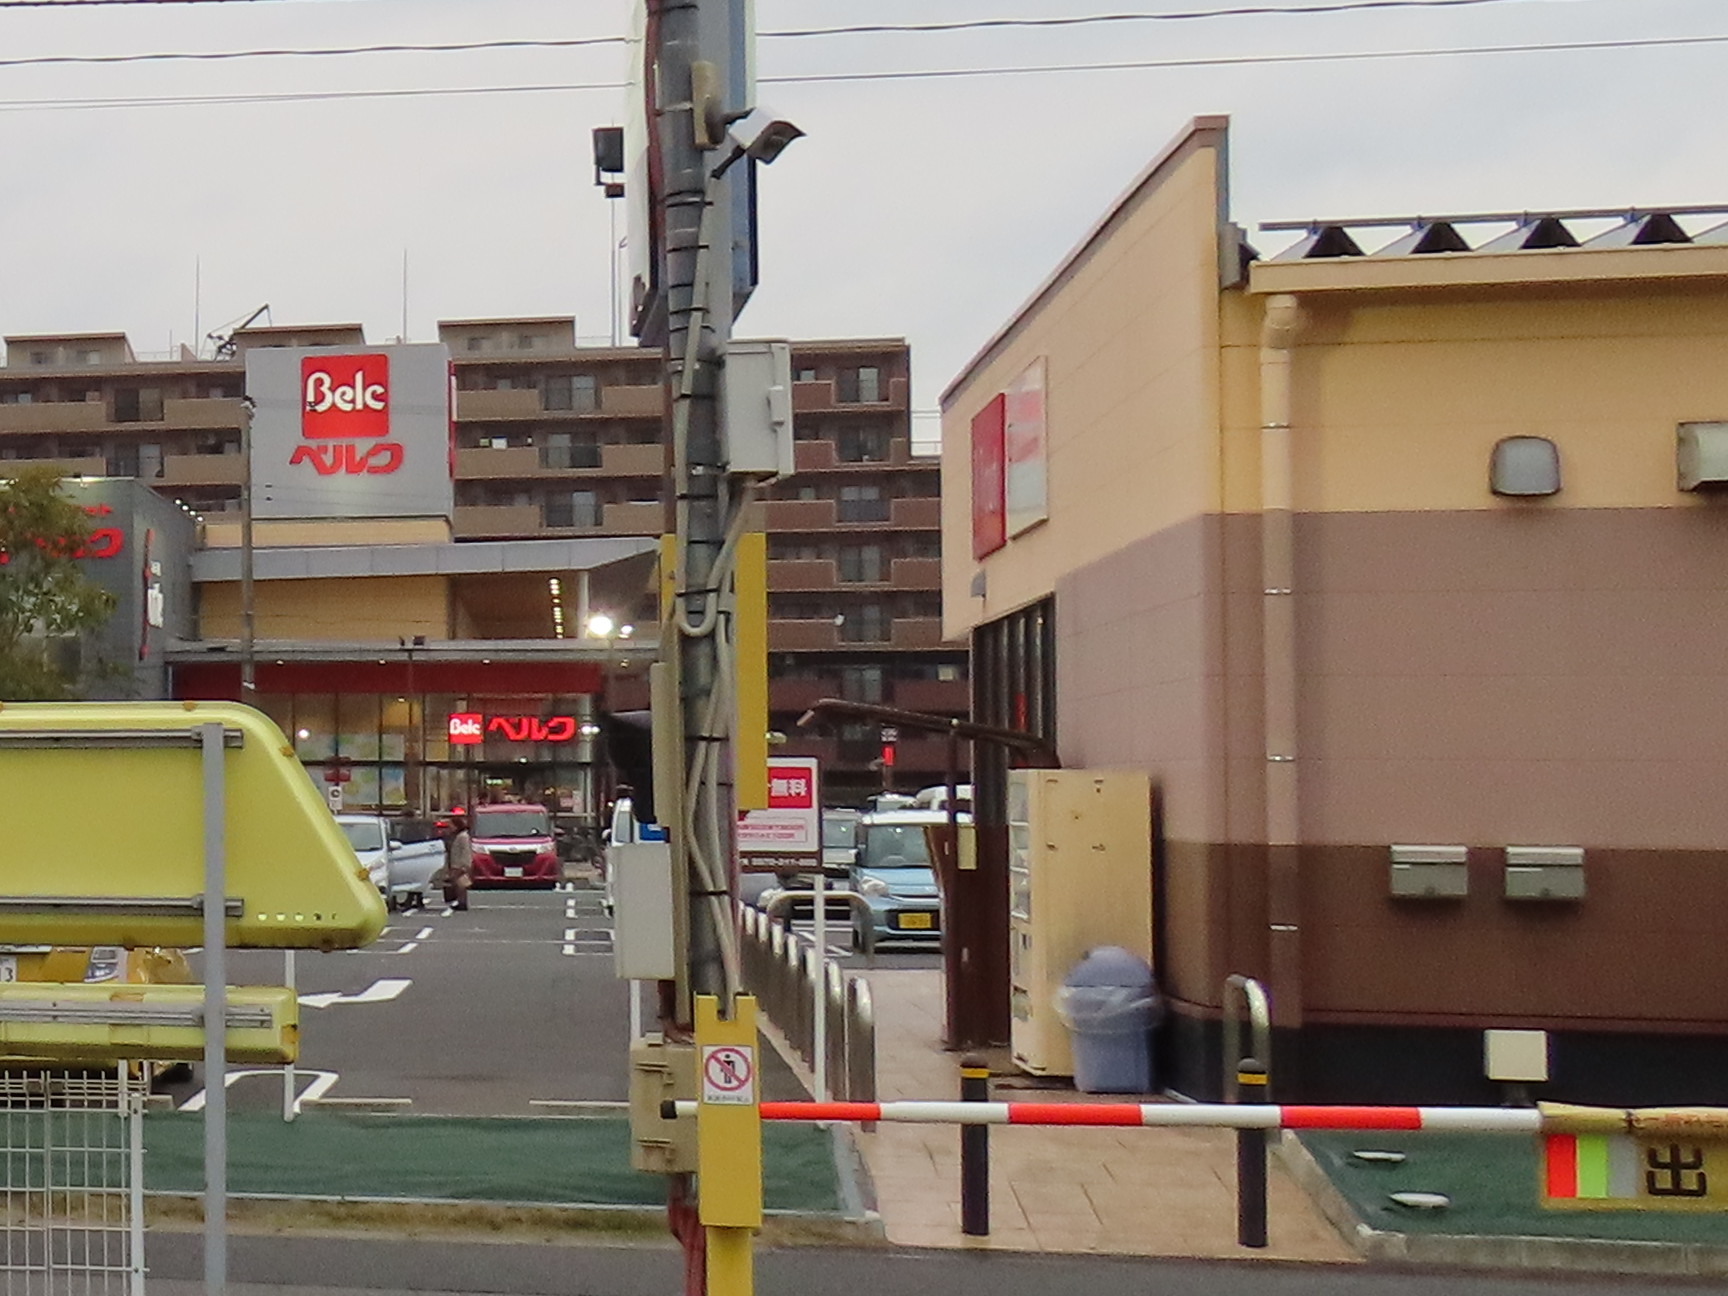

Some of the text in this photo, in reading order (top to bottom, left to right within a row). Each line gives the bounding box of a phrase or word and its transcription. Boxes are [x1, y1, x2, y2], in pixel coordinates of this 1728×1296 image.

[306, 369, 386, 413] Belc
[289, 442, 405, 476] ベルク
[449, 718, 482, 735] Belc
[487, 716, 577, 741] ベルク
[1646, 1143, 1707, 1196] 出
